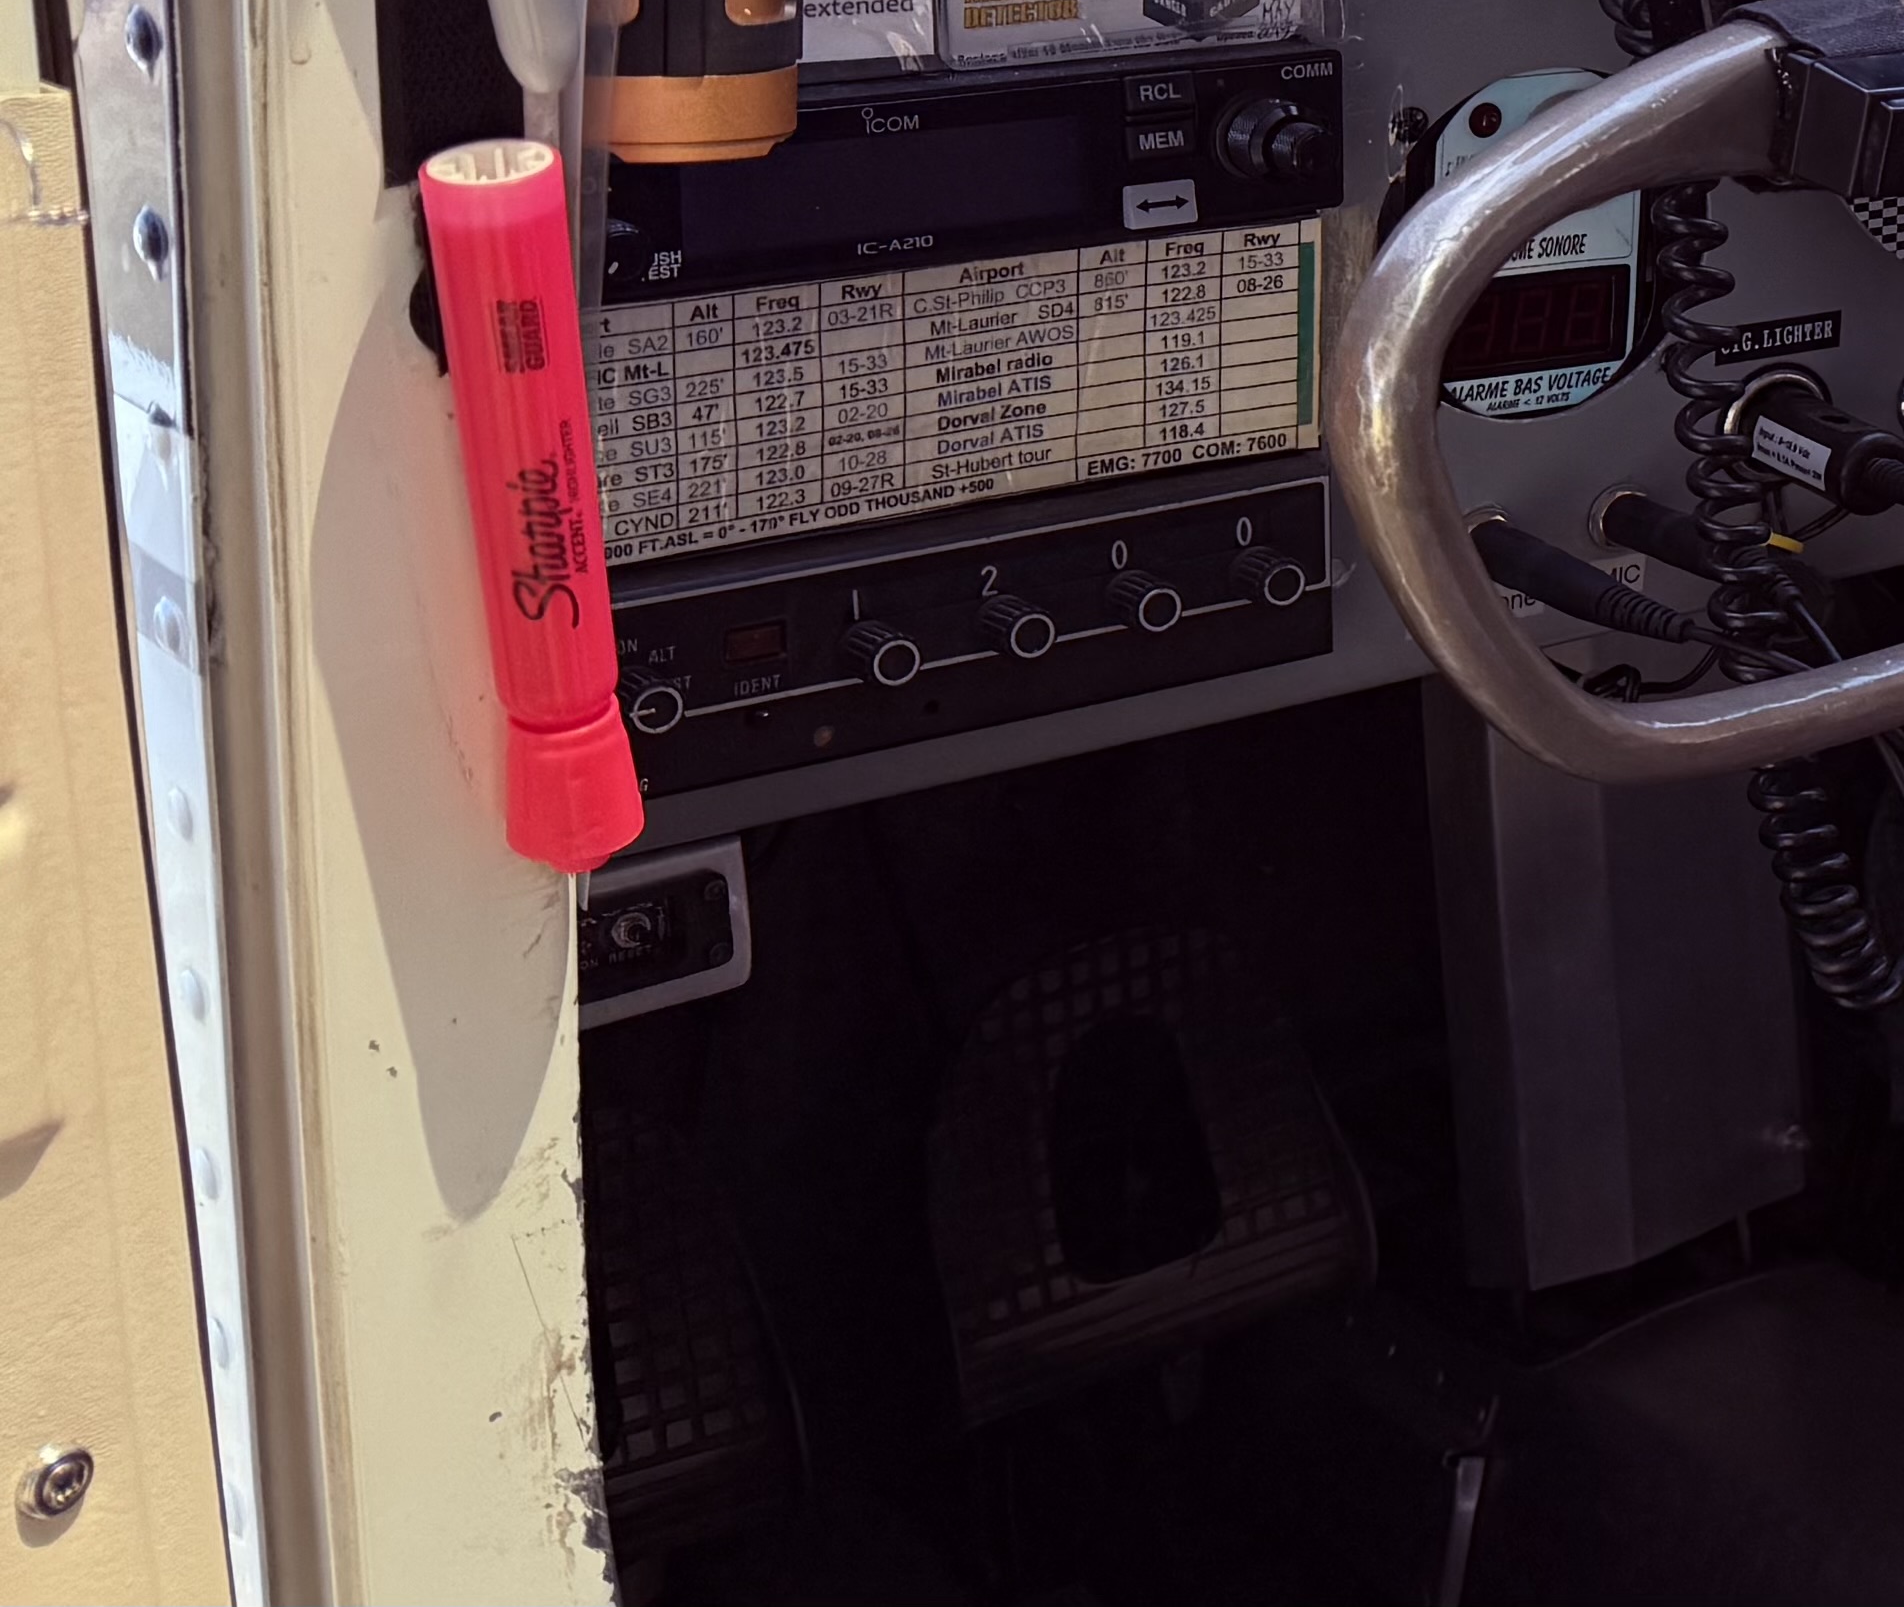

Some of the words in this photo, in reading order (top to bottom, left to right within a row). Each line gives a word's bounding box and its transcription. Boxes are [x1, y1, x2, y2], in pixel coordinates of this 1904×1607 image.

[1138, 82, 1181, 102] RCL
[1280, 62, 1334, 80] COMM
[1138, 129, 1185, 150] MEM
[755, 295, 801, 313] Freq
[840, 282, 883, 300] Rwy
[1243, 231, 1282, 248] Rwy
[857, 235, 934, 256] IC-A210
[1537, 233, 1588, 256] SONORE
[627, 335, 669, 355] SA2
[752, 316, 803, 337] 123.2
[827, 305, 894, 327] 03-21R
[1160, 261, 1207, 280] 123.2
[1237, 252, 1284, 270] 15-33
[740, 341, 816, 364] 123.475
[1160, 284, 1207, 303] 122.8
[1236, 275, 1284, 293] 08-26
[752, 367, 804, 388] 123.5
[839, 353, 888, 375] 15-33
[1015, 324, 1075, 346] AWOS
[1149, 306, 1217, 328] 123.425
[629, 438, 672, 457] SU3
[754, 416, 806, 438] 123.2
[837, 402, 889, 424] 02-20
[1159, 354, 1205, 374] 126.1
[631, 412, 673, 431] SB3
[754, 391, 806, 413] 122.7
[839, 378, 889, 399] 15-33
[1159, 331, 1206, 350] 119.1
[1513, 377, 1543, 396] BAS
[1548, 366, 1613, 393] VOLTAGE
[634, 464, 675, 483] ST3
[999, 402, 1047, 419] Zone
[1154, 376, 1212, 396] 134.15
[1087, 457, 1136, 477] EMG:
[1141, 448, 1183, 468] 7700
[1191, 442, 1241, 460] COM:
[1246, 433, 1288, 453] 7600
[614, 512, 675, 536] CYND
[830, 472, 895, 497] 09-27R
[1158, 422, 1205, 441] 118.4
[632, 489, 672, 509] SE4
[755, 465, 806, 487] 123.0
[839, 450, 888, 472] 10-28
[824, 501, 861, 519] ODD
[866, 485, 955, 513] THOUSAND
[506, 458, 581, 630] Sharpie
[734, 674, 781, 696] IDENT
